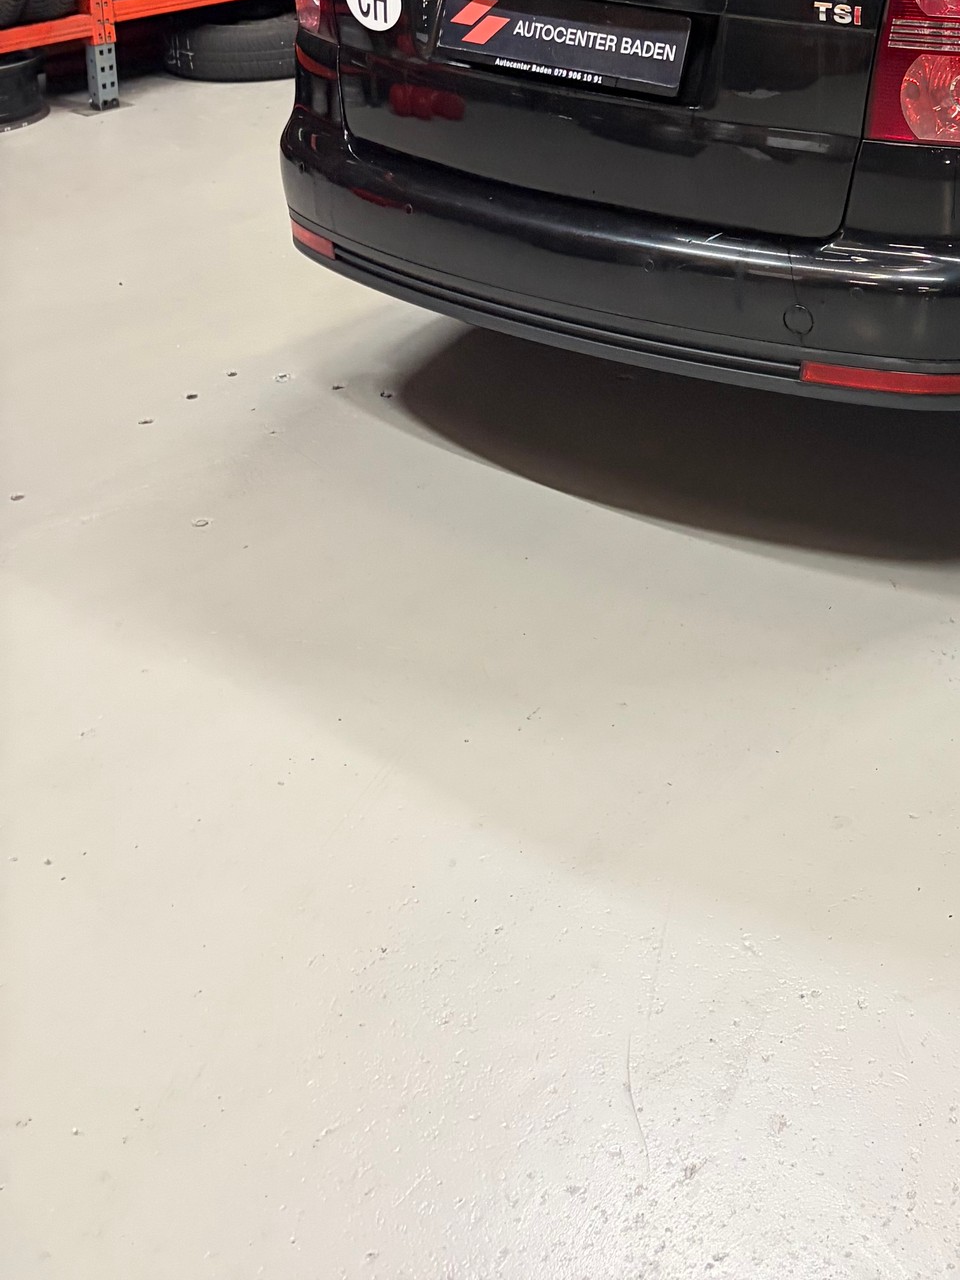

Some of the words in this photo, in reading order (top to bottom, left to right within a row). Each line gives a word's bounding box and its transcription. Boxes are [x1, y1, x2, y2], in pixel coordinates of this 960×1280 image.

[813, 1, 862, 26] TSI
[513, 20, 617, 53] AUTOCENTER
[620, 37, 677, 62] BADEN
[495, 57, 531, 71] Autocenter
[531, 64, 552, 75] Baden
[553, 68, 567, 78] 079
[568, 70, 582, 81] 906
[582, 73, 592, 82] 10
[593, 75, 603, 84] 91
